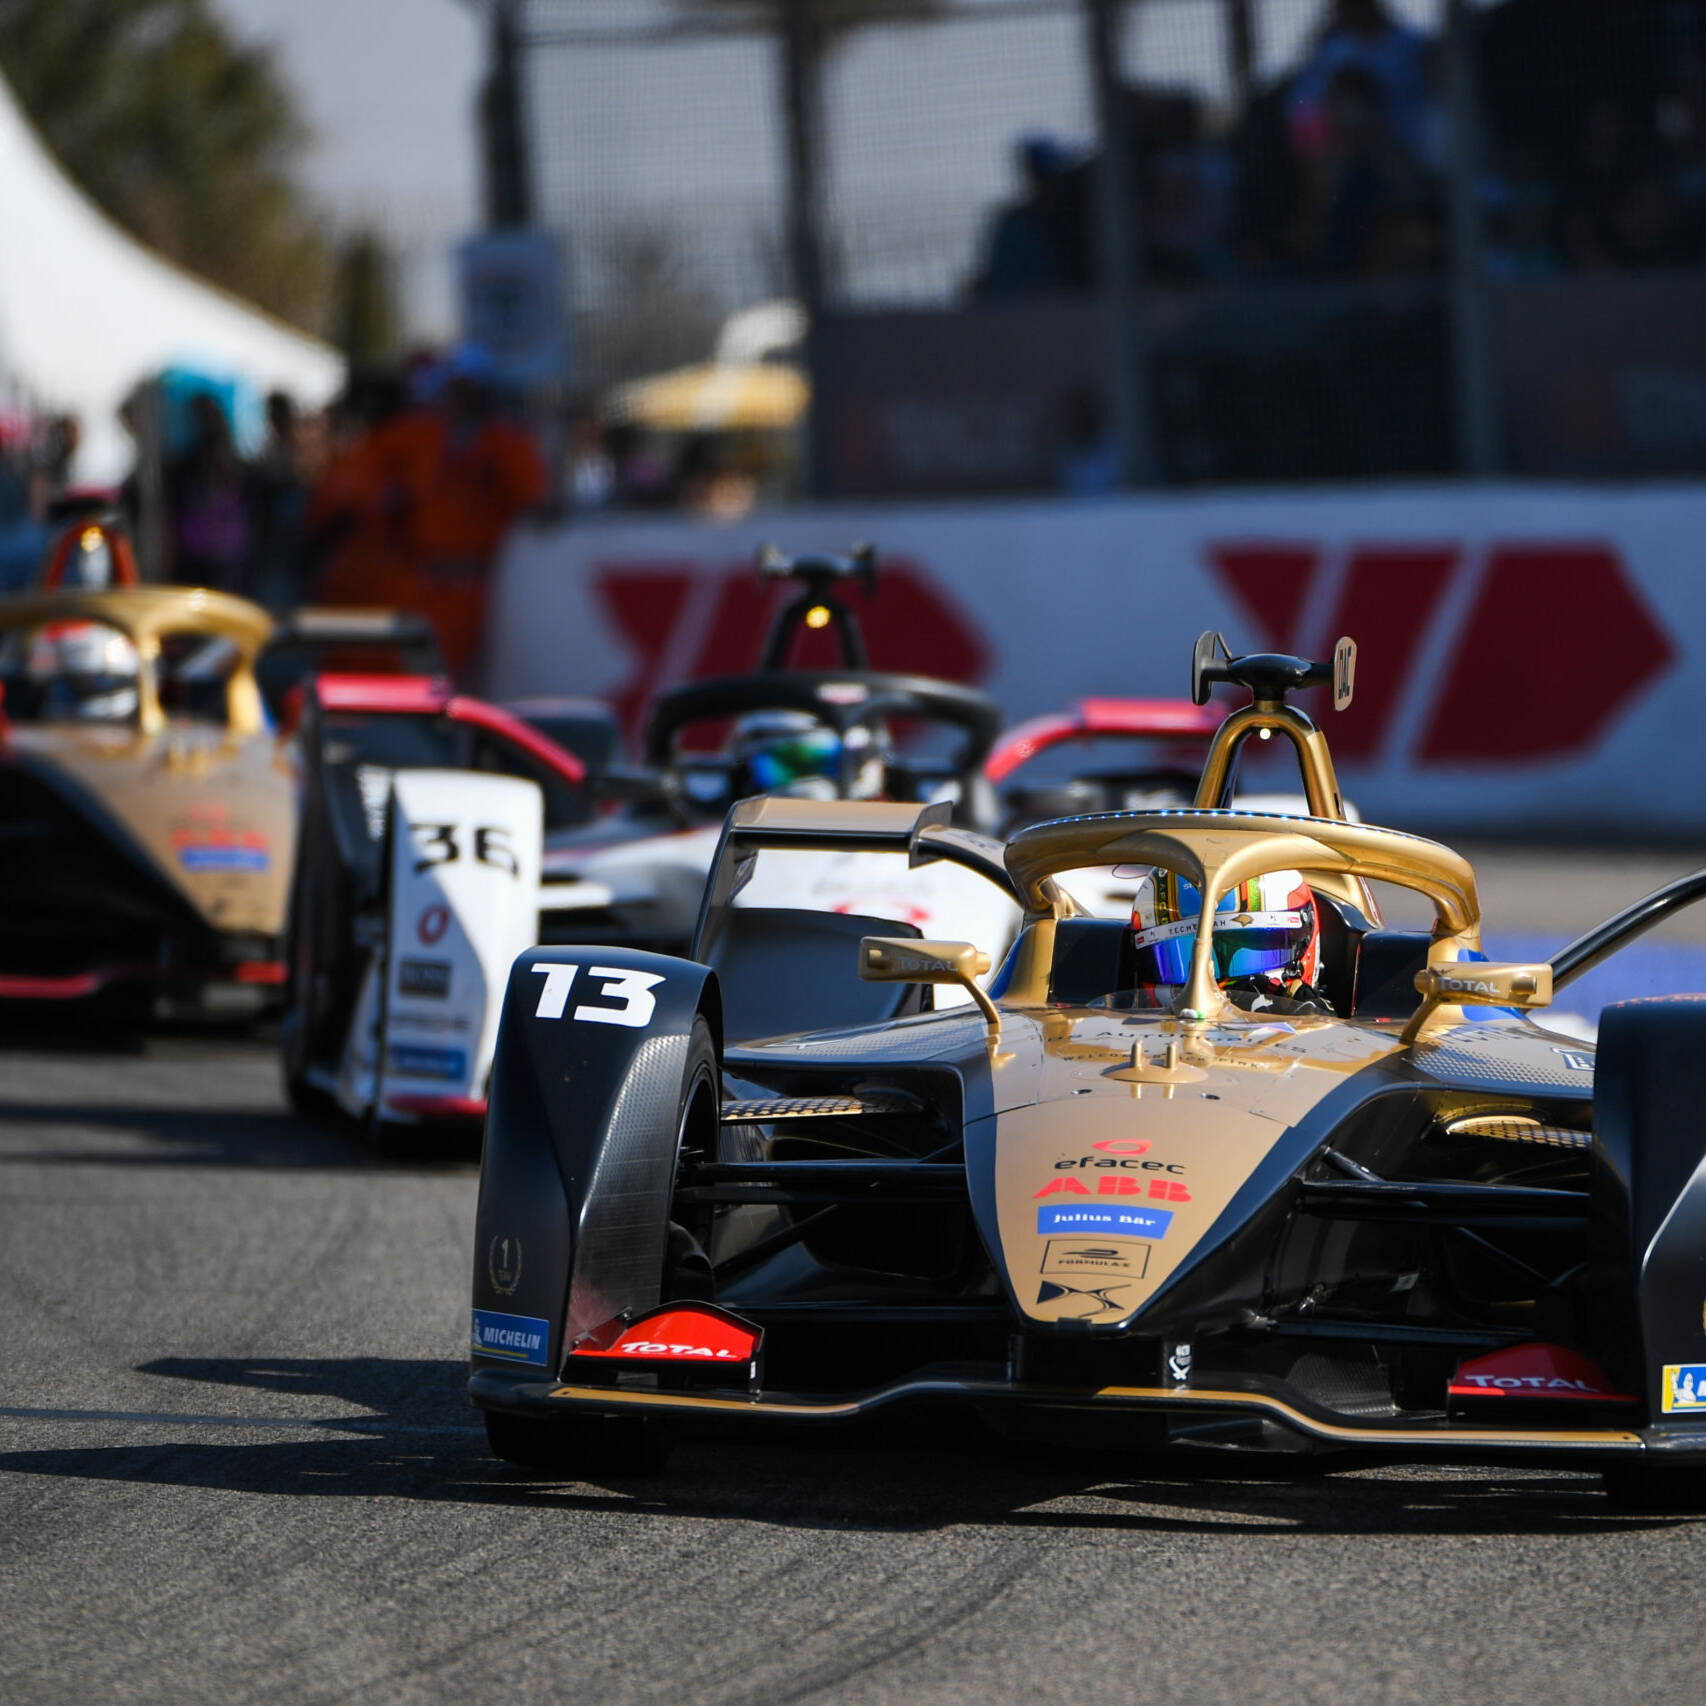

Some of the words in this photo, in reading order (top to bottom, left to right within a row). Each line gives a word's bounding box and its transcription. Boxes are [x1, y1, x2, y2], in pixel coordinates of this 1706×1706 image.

[410, 824, 519, 879] 36
[1168, 919, 1226, 935] TECHEAH
[900, 957, 959, 972] TOTAL
[1439, 976, 1501, 993] TOTAL
[531, 963, 667, 1028] 13
[1054, 1156, 1185, 1174] efacec
[1032, 1176, 1192, 1203] ABB
[483, 1327, 541, 1350] MICHELIN
[622, 1341, 738, 1358] TOTAL
[1465, 1375, 1601, 1393] TOTAL
